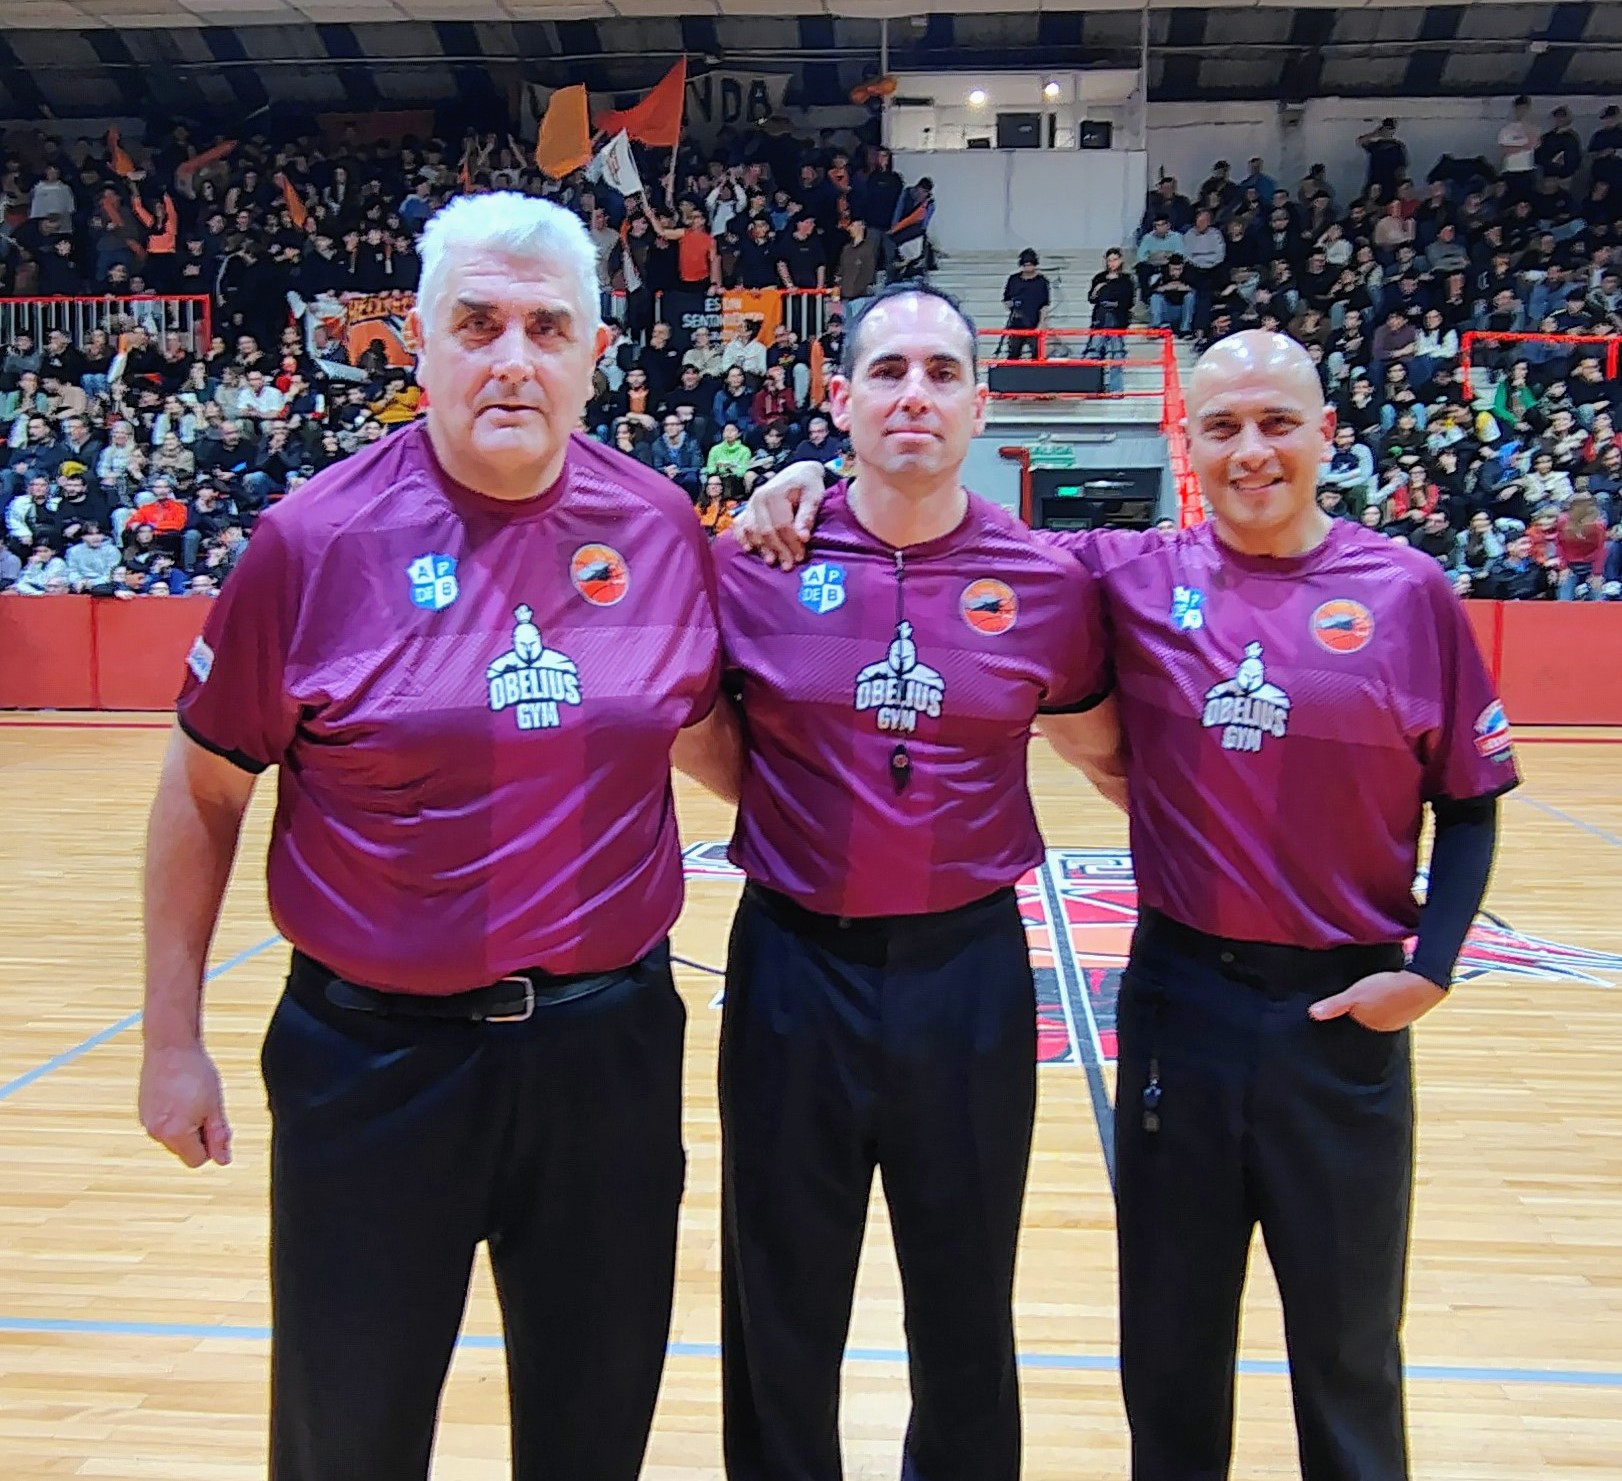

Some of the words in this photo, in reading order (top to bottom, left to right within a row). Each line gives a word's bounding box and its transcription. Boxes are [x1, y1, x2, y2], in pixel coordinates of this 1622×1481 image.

[688, 76, 773, 123] NDA
[417, 564, 432, 579] A
[436, 561, 449, 576] P
[808, 570, 820, 583] A
[828, 569, 840, 582] P
[442, 581, 452, 596] B
[827, 589, 838, 601] B
[489, 669, 582, 711] OBELIUS
[855, 677, 943, 718] OBELIUS
[516, 702, 560, 730] GYM
[877, 708, 917, 732] GYM
[1202, 697, 1287, 738] OBELIUS
[1221, 726, 1263, 752] GYM
